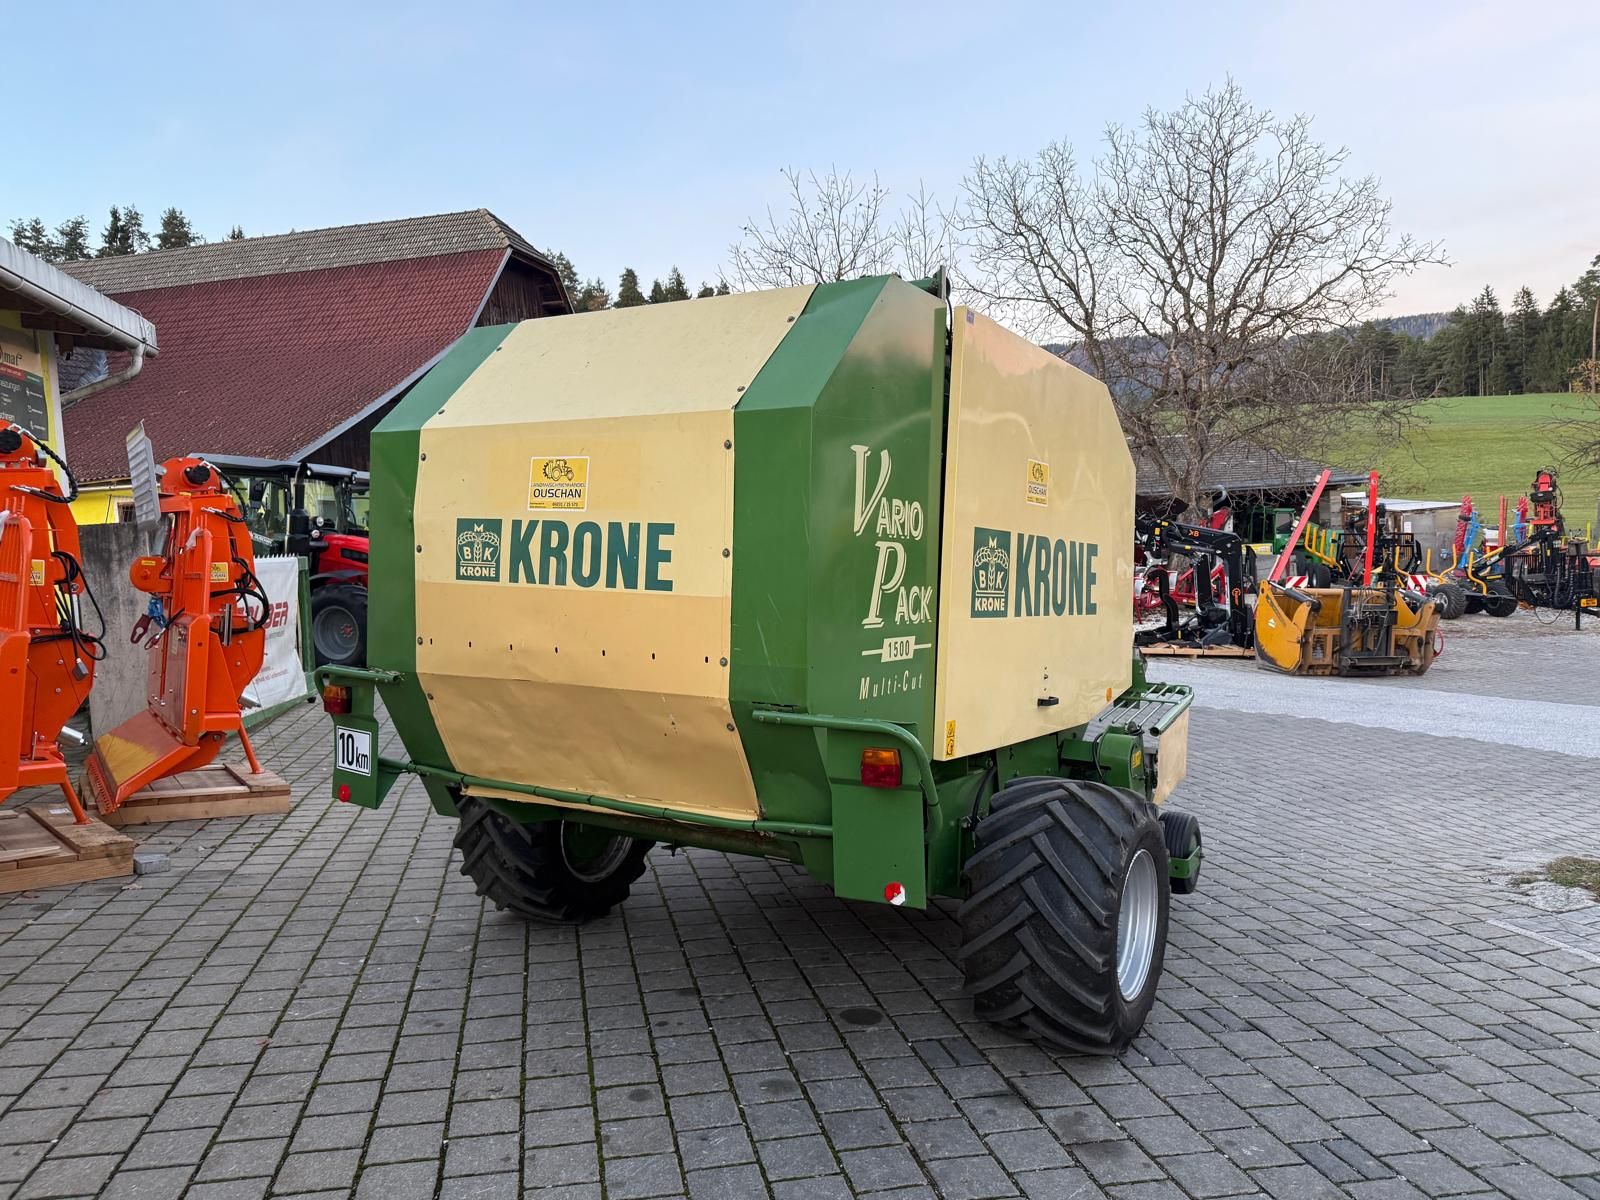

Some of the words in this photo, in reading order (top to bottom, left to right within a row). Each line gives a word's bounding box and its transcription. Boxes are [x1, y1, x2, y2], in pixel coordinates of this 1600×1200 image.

[533, 488, 582, 498] OUSCHAN
[474, 523, 484, 532] M
[988, 536, 997, 548] M
[463, 547, 472, 560] B
[484, 547, 494, 561] K
[509, 519, 675, 592] KRONE
[460, 566, 496, 577] KRONE
[1014, 532, 1098, 618] KRONE
[979, 570, 986, 588] B
[996, 570, 1004, 589] K
[975, 597, 1005, 611] KRONE
[888, 640, 910, 658] 1500
[859, 670, 922, 700] Multi-Cut
